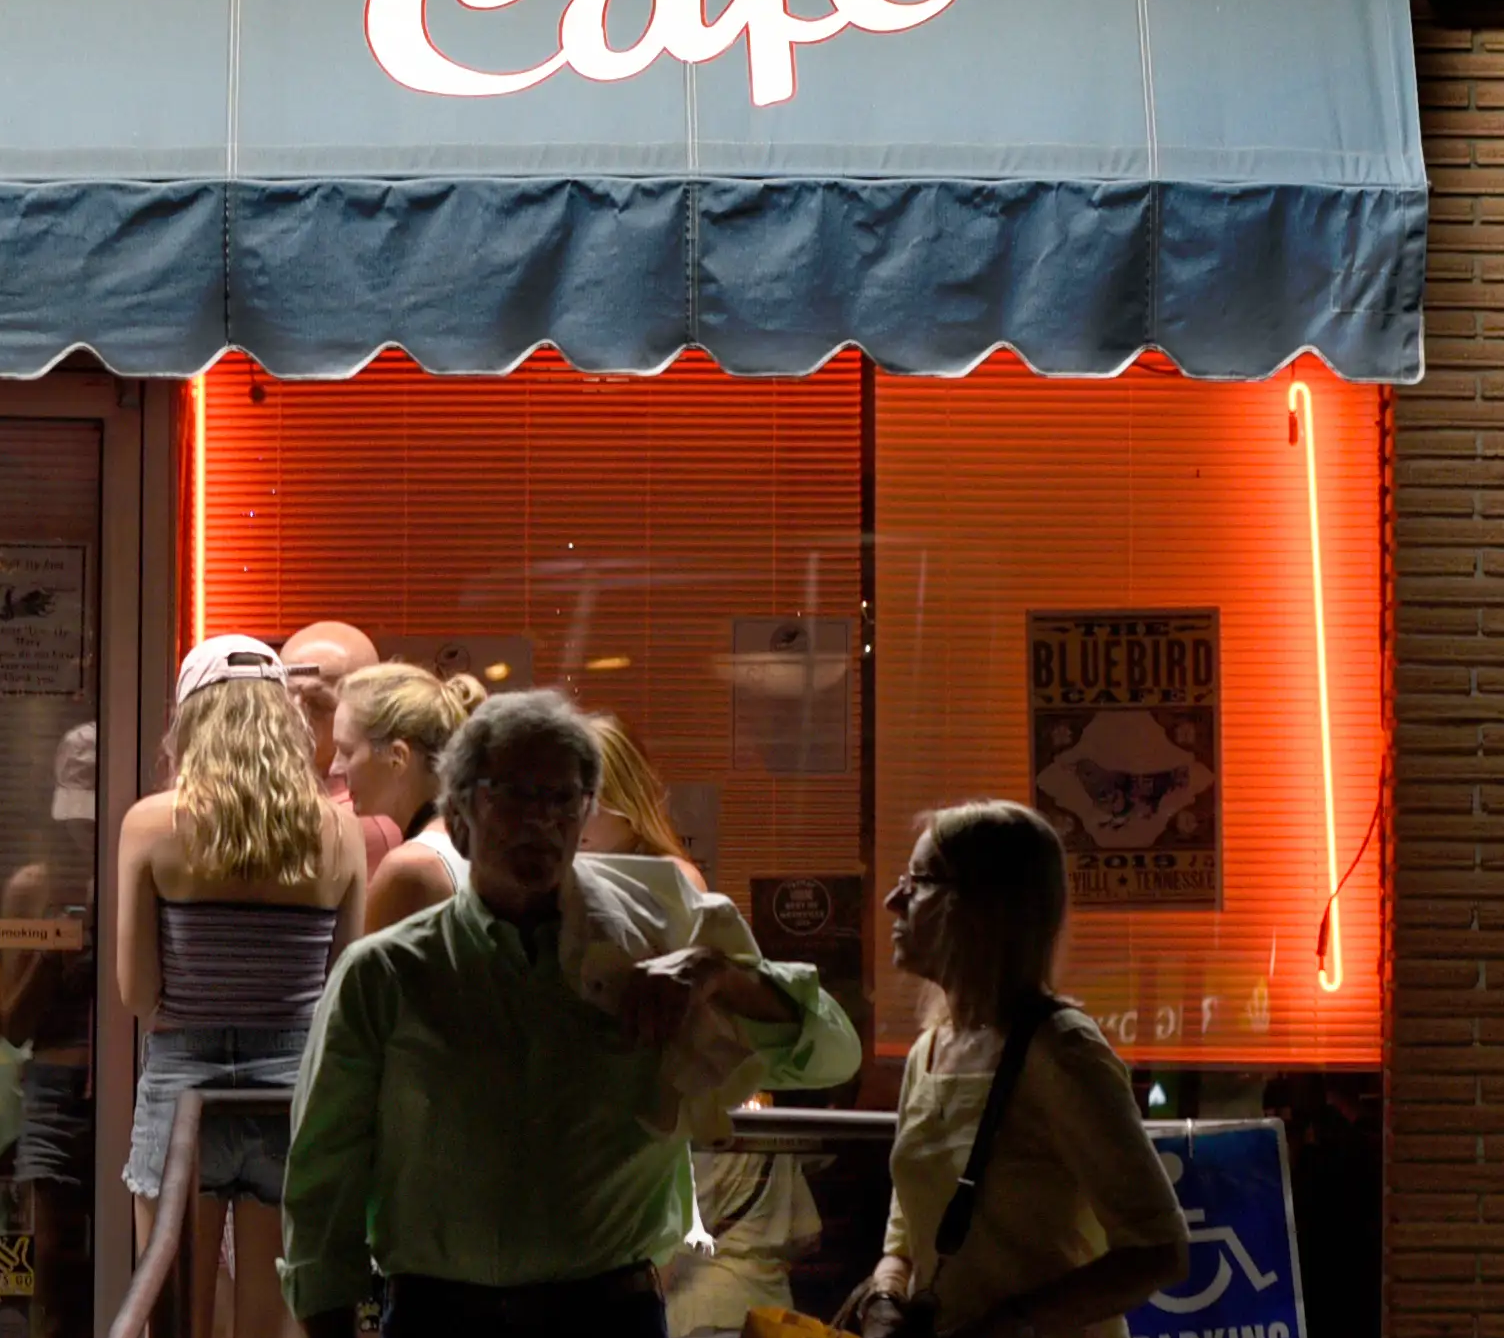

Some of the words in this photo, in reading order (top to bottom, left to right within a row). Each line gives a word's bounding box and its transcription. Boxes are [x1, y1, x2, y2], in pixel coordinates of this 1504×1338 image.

[1074, 622, 1171, 637] THE
[1033, 639, 1214, 689] BLUEBIRD
[1060, 688, 1188, 705] CAFE
[1136, 870, 1215, 892] TENNESSEE
